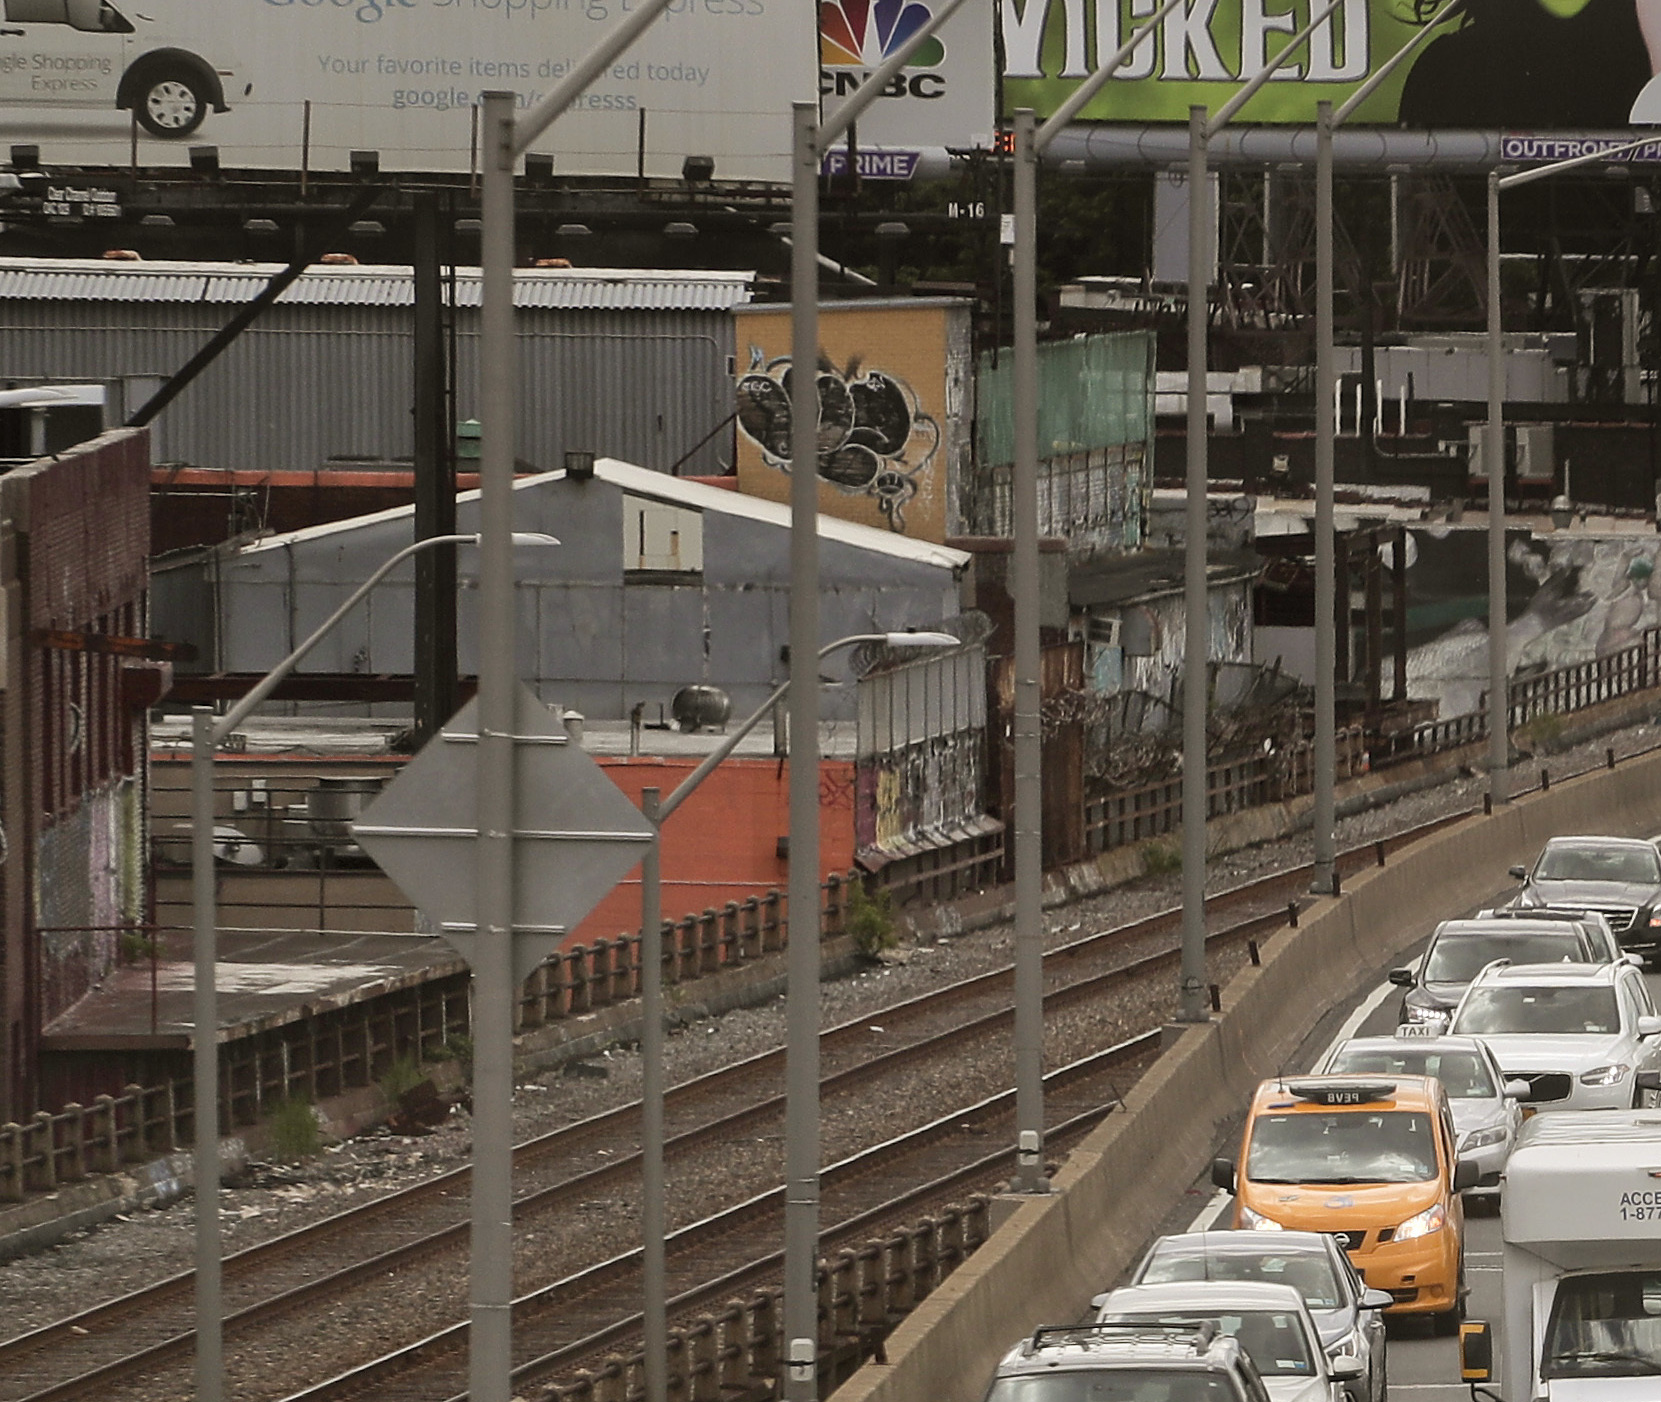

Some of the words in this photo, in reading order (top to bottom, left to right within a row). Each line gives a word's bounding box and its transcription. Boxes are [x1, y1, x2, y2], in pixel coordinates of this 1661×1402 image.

[32, 54, 111, 74] Shopping
[318, 54, 370, 74] Your
[377, 54, 462, 76] favorite
[470, 56, 530, 79] items
[537, 58, 640, 80] delired
[648, 61, 710, 86] today
[32, 75, 98, 92] Express
[829, 154, 910, 175] PRIME
[1402, 1026, 1430, 1037] TAXI
